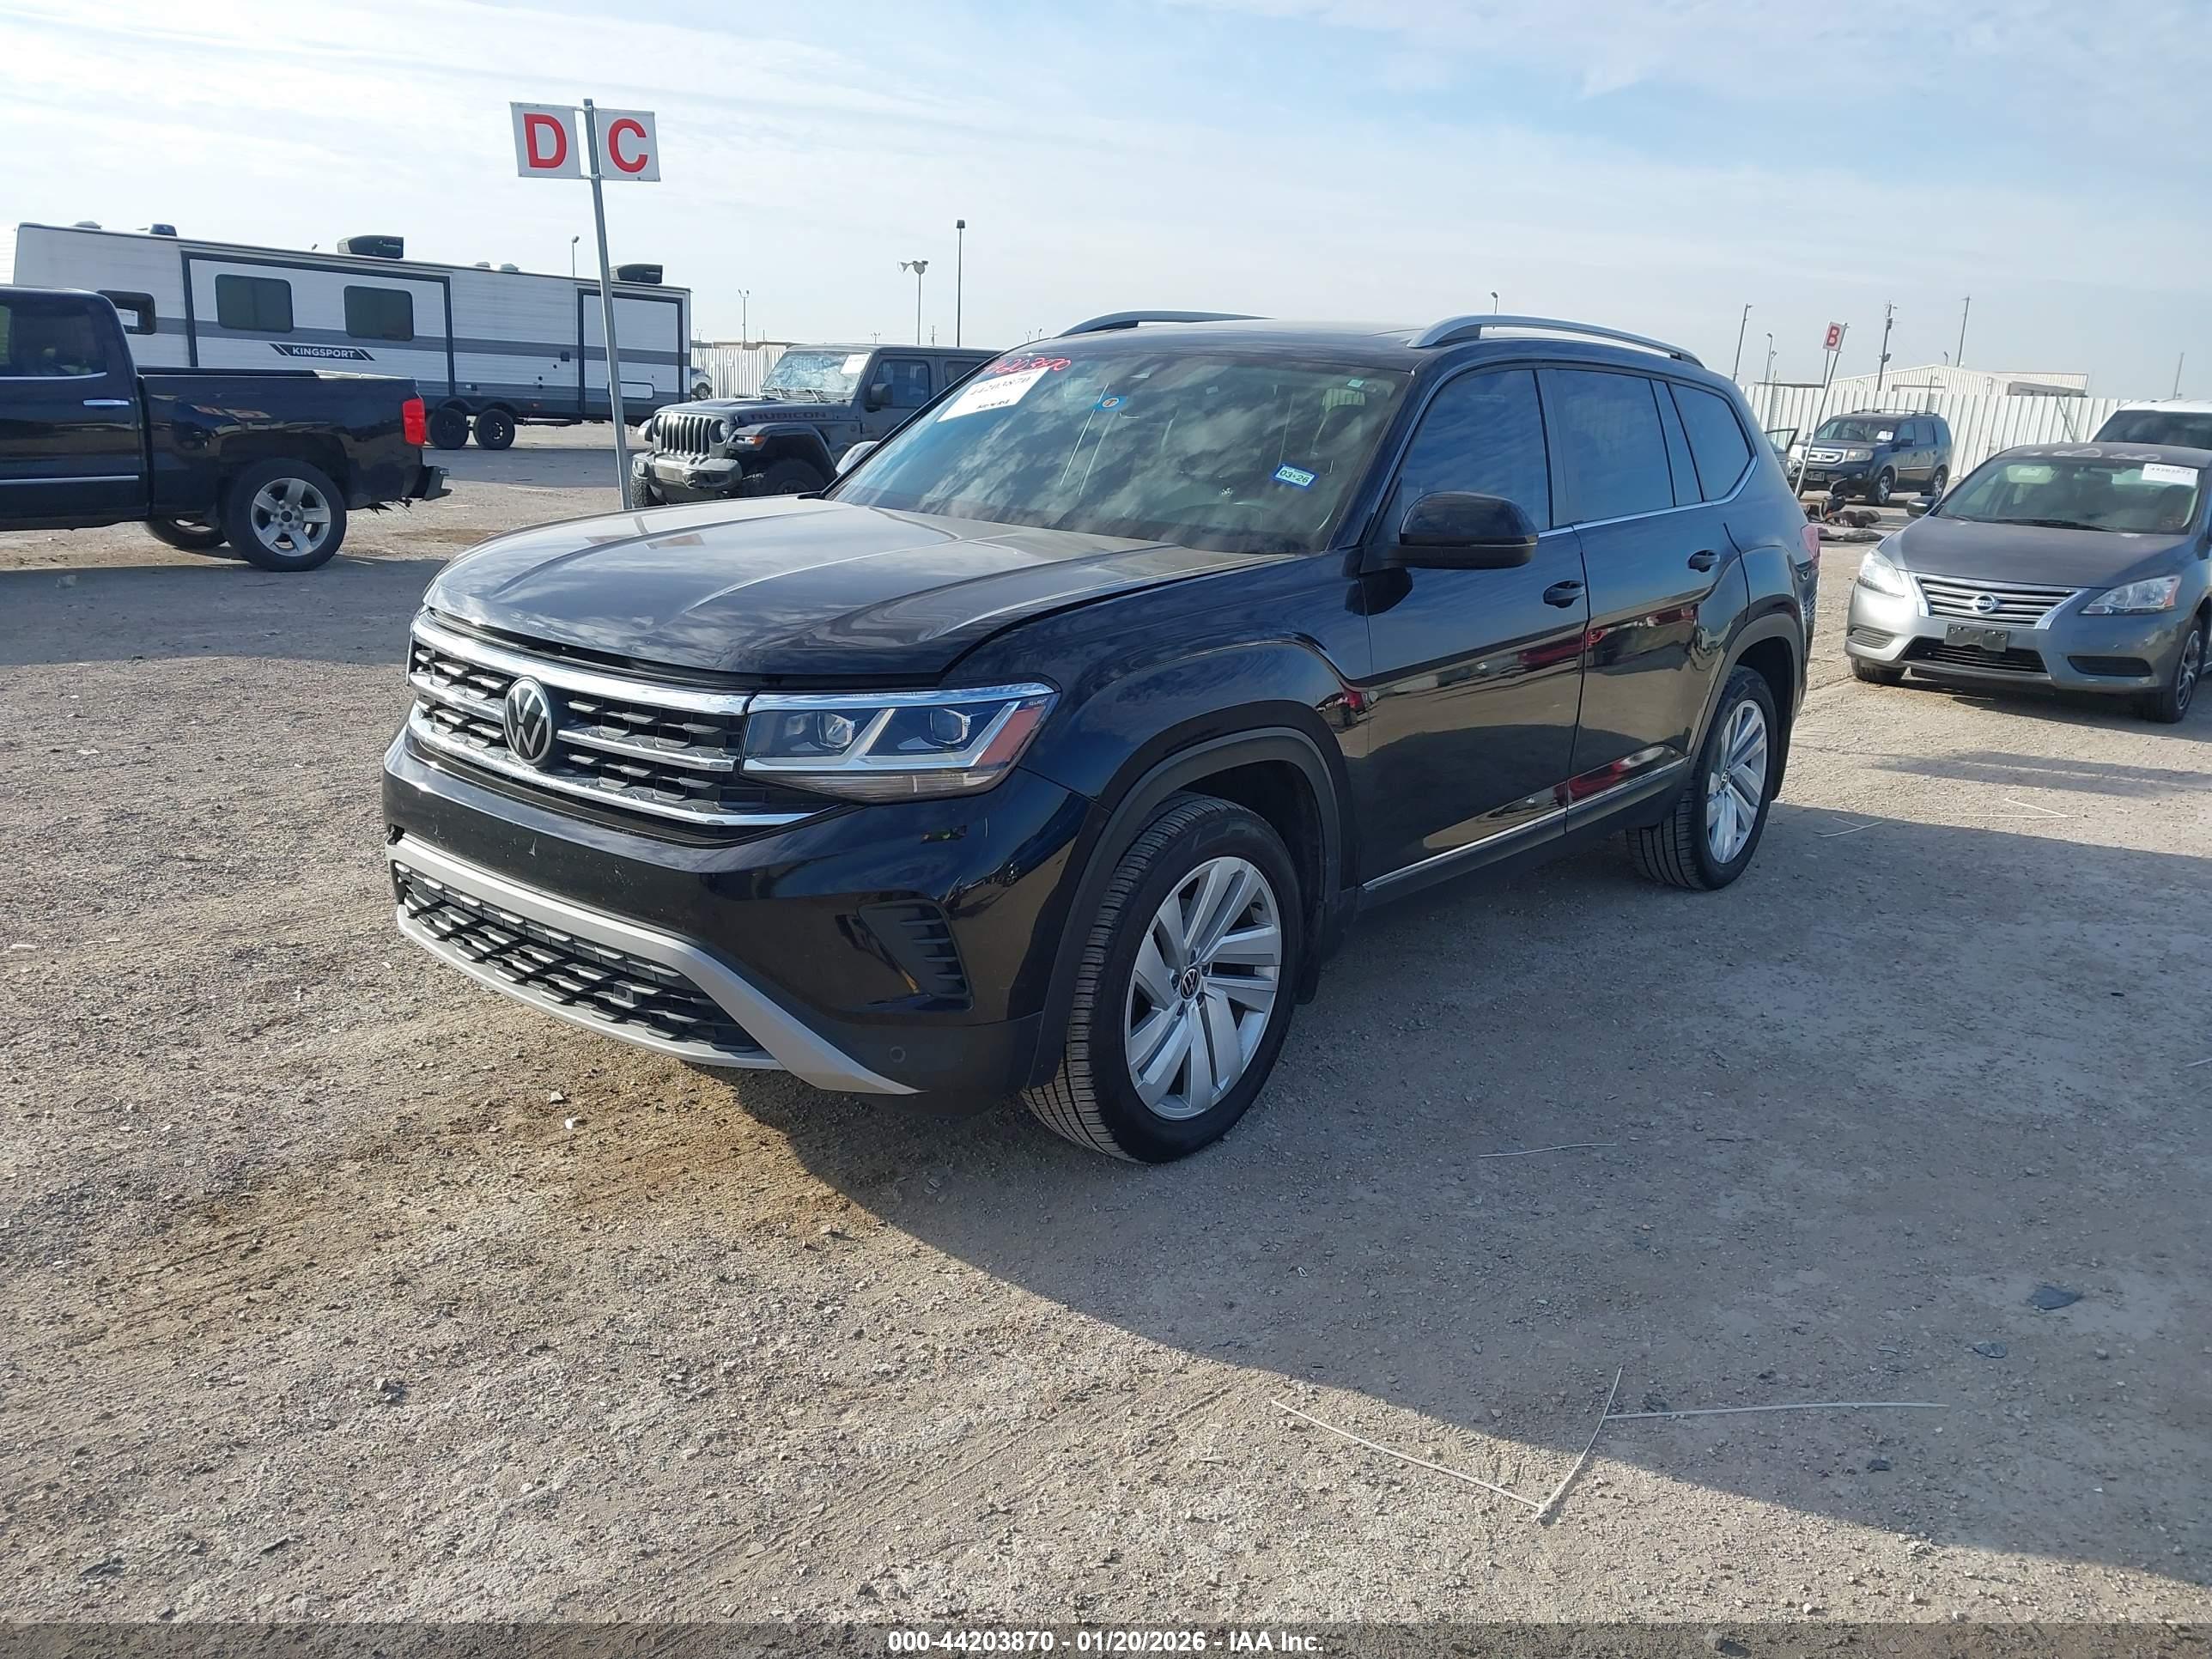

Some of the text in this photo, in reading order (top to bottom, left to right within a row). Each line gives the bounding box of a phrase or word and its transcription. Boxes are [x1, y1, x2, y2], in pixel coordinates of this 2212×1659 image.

[523, 112, 568, 169] D
[608, 118, 648, 173] C
[1826, 325, 1840, 347] B
[292, 346, 356, 358] KINGSPORT
[750, 411, 827, 420] RUBICON
